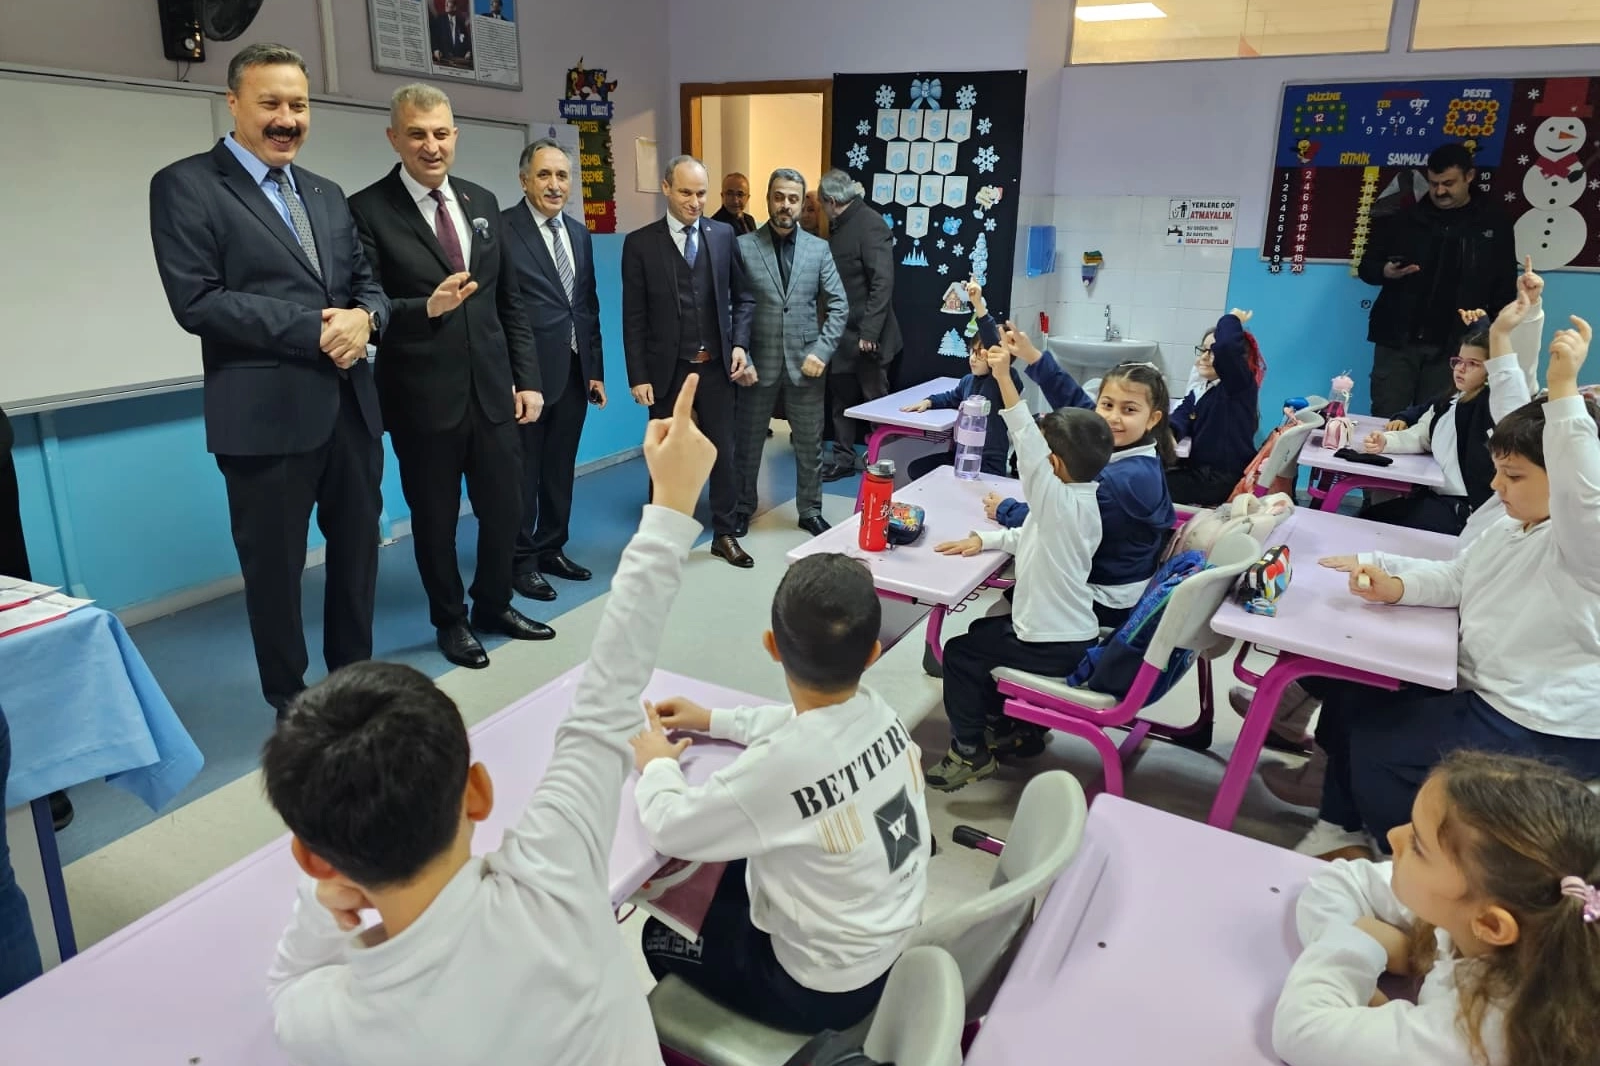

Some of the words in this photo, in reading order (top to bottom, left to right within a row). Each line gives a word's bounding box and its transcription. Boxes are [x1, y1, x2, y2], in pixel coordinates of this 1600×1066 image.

[1462, 88, 1492, 98] DESTE
[1377, 99, 1392, 109] TEK
[1376, 108, 1384, 117] 3
[1415, 107, 1422, 116] 2
[1313, 113, 1325, 122] 12
[1361, 116, 1367, 125] 1
[1389, 116, 1396, 125] 5
[1398, 116, 1406, 124] 0
[1427, 117, 1435, 125] 4
[1466, 113, 1477, 122] 10
[1366, 126, 1373, 135] 9
[1380, 127, 1387, 135] 7
[1406, 126, 1413, 135] 8
[1418, 127, 1426, 136] 6
[1386, 152, 1430, 166] SAYMALA
[1284, 172, 1289, 180] 1
[1305, 171, 1312, 179] 2
[1480, 171, 1491, 181] 10
[1282, 184, 1289, 192] 2
[1303, 183, 1310, 191] 4
[1281, 194, 1288, 202] 3
[1303, 193, 1310, 201] 6
[1221, 201, 1235, 211] ÇÖP
[1279, 204, 1286, 212] 4
[1302, 203, 1308, 211] 8
[1190, 210, 1233, 220] ATMAYALIM.
[1278, 214, 1285, 222] 5
[1299, 213, 1309, 221] 10
[1298, 223, 1308, 231] 12
[1276, 235, 1282, 243] 7
[1296, 234, 1306, 242] 14
[1294, 244, 1304, 252] 16
[1273, 254, 1280, 262] 9
[1293, 254, 1303, 262] 18
[1270, 265, 1280, 273] 10
[1291, 263, 1303, 272] 20
[789, 717, 911, 820] BETTER
[887, 813, 908, 842] W
